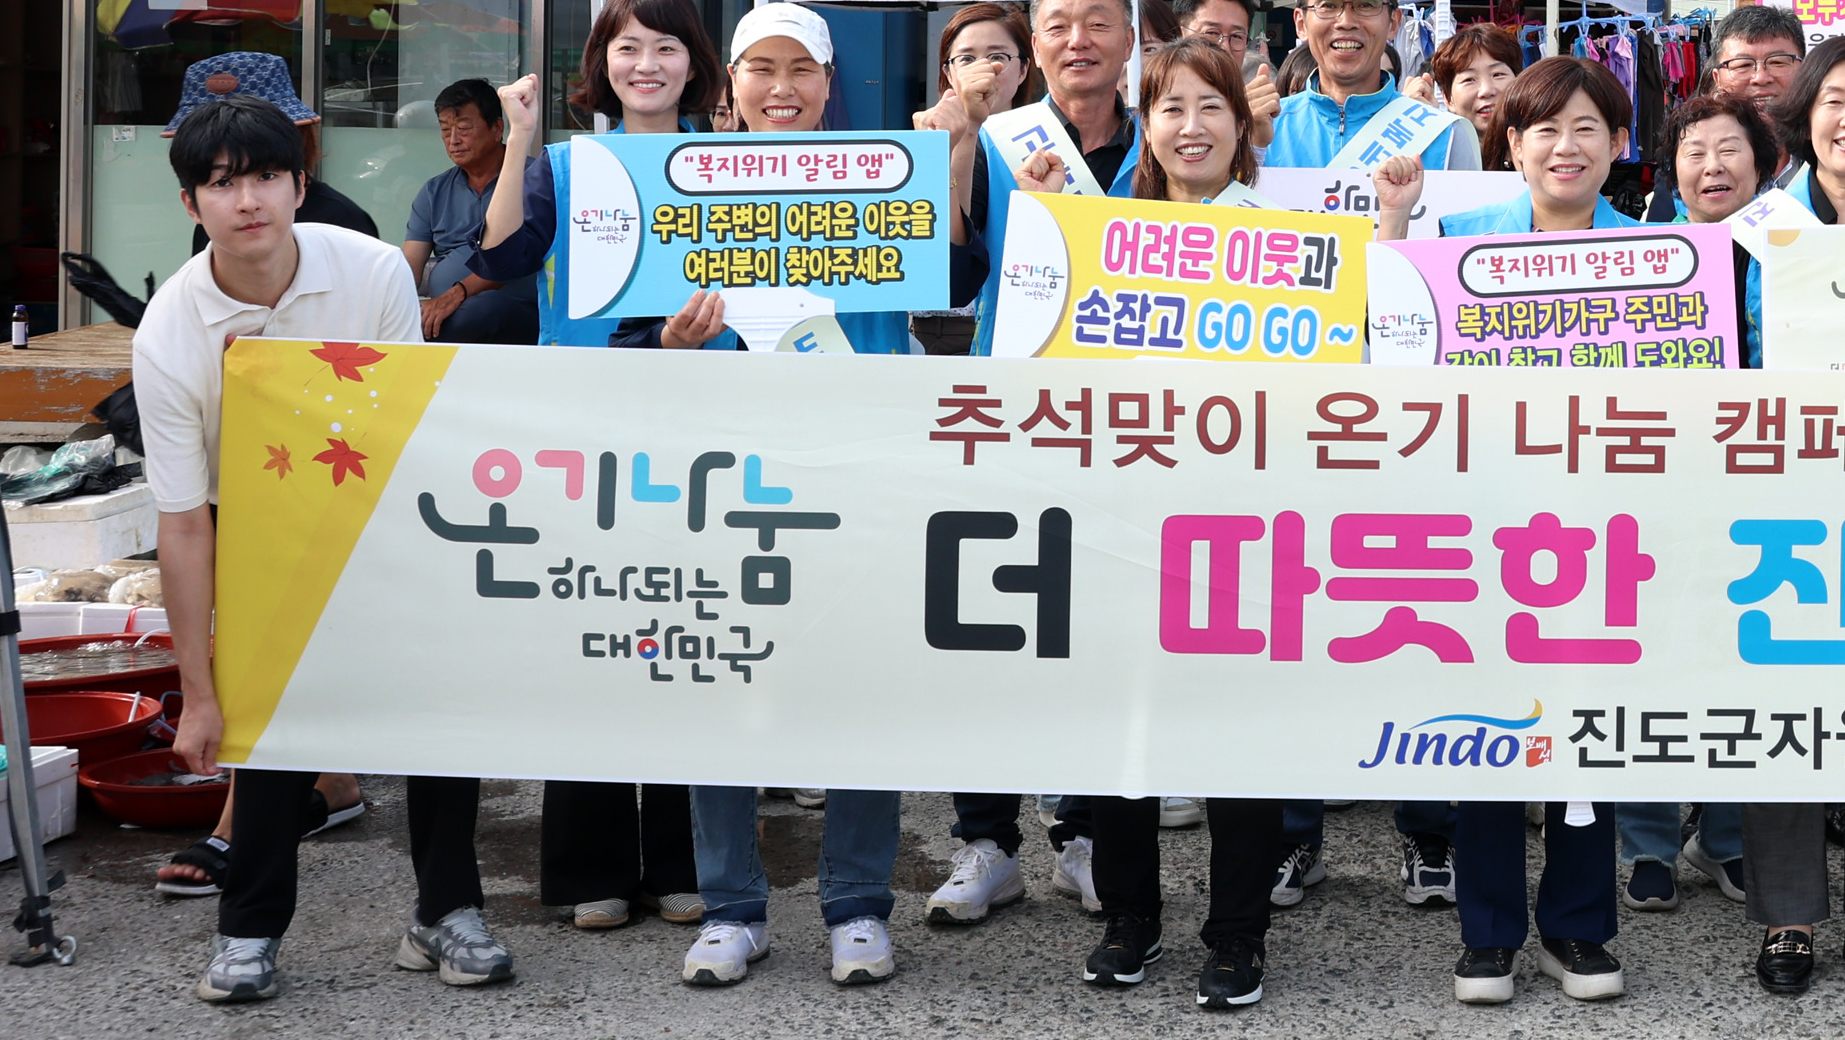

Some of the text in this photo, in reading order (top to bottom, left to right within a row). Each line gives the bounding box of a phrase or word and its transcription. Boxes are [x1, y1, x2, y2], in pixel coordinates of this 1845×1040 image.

[796, 153, 849, 180] 알림
[573, 209, 637, 232] 온기나눔
[652, 199, 936, 243] 우리 주변의 어려운 이웃을
[684, 246, 904, 287] 여러분이 찾아주세요
[1004, 264, 1065, 288] 온기나눔
[1104, 220, 1338, 291] 어려운 이웃과
[1585, 250, 1635, 278] 알림
[1075, 290, 1318, 356] 손잡고 GO GO
[1372, 313, 1434, 337] 온기나눔
[1457, 292, 1708, 341] 복지위기가구 주민과
[1635, 337, 1726, 369] 도와요!
[928, 385, 1269, 471] 추석맞이
[1306, 393, 1470, 473] 온기
[1513, 395, 1676, 475] 나눔
[418, 449, 841, 605] 온기나눔
[549, 557, 729, 620] 하나되는
[925, 507, 1072, 659] 더
[1159, 510, 1656, 665] 따뜻한
[583, 619, 775, 683] 대한민국
[1358, 721, 1520, 769] Jindo
